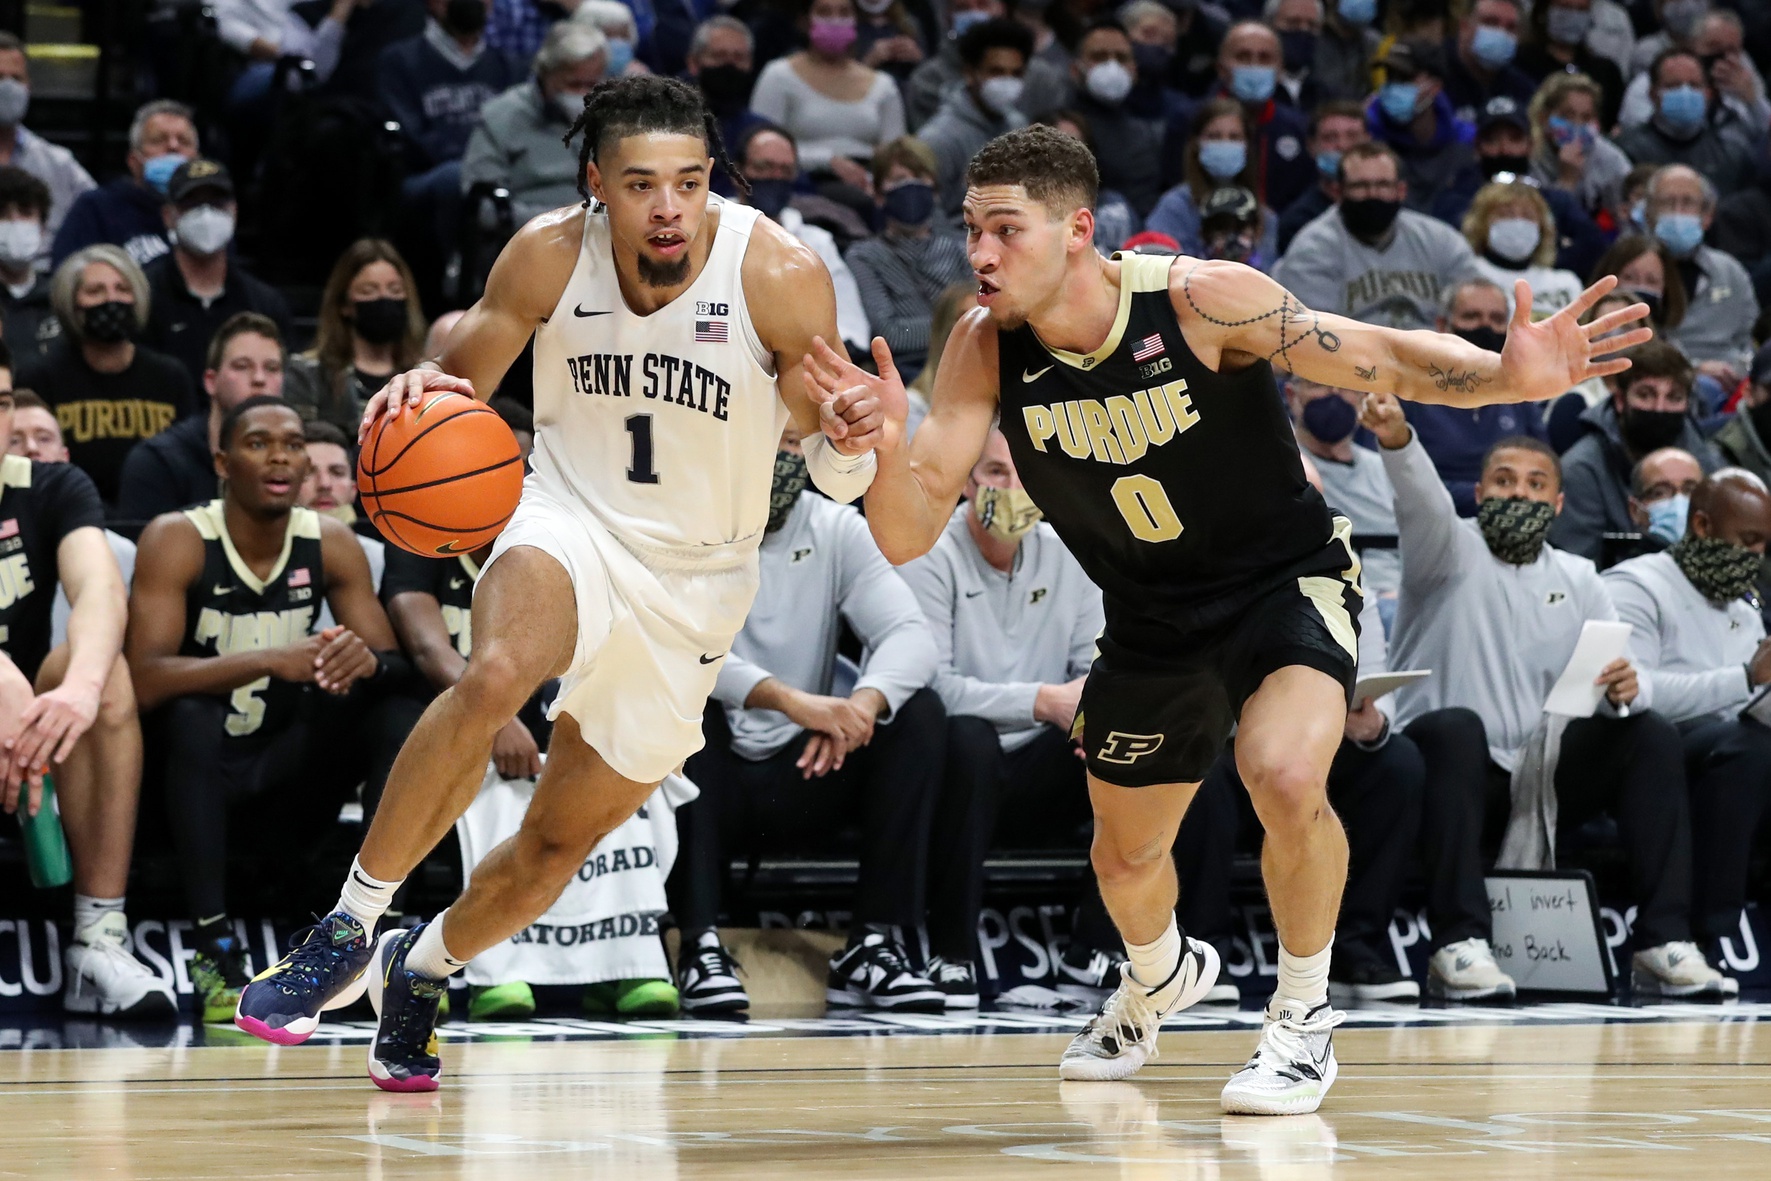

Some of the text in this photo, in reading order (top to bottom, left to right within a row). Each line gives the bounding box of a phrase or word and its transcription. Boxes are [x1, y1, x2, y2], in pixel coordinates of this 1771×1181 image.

[566, 352, 732, 422] PENN STATE
[1021, 378, 1201, 466] PURDUE
[624, 412, 662, 486] 1
[1109, 473, 1185, 543] 0
[1030, 588, 1047, 605] P
[224, 674, 271, 738] 5
[1096, 730, 1165, 765] P
